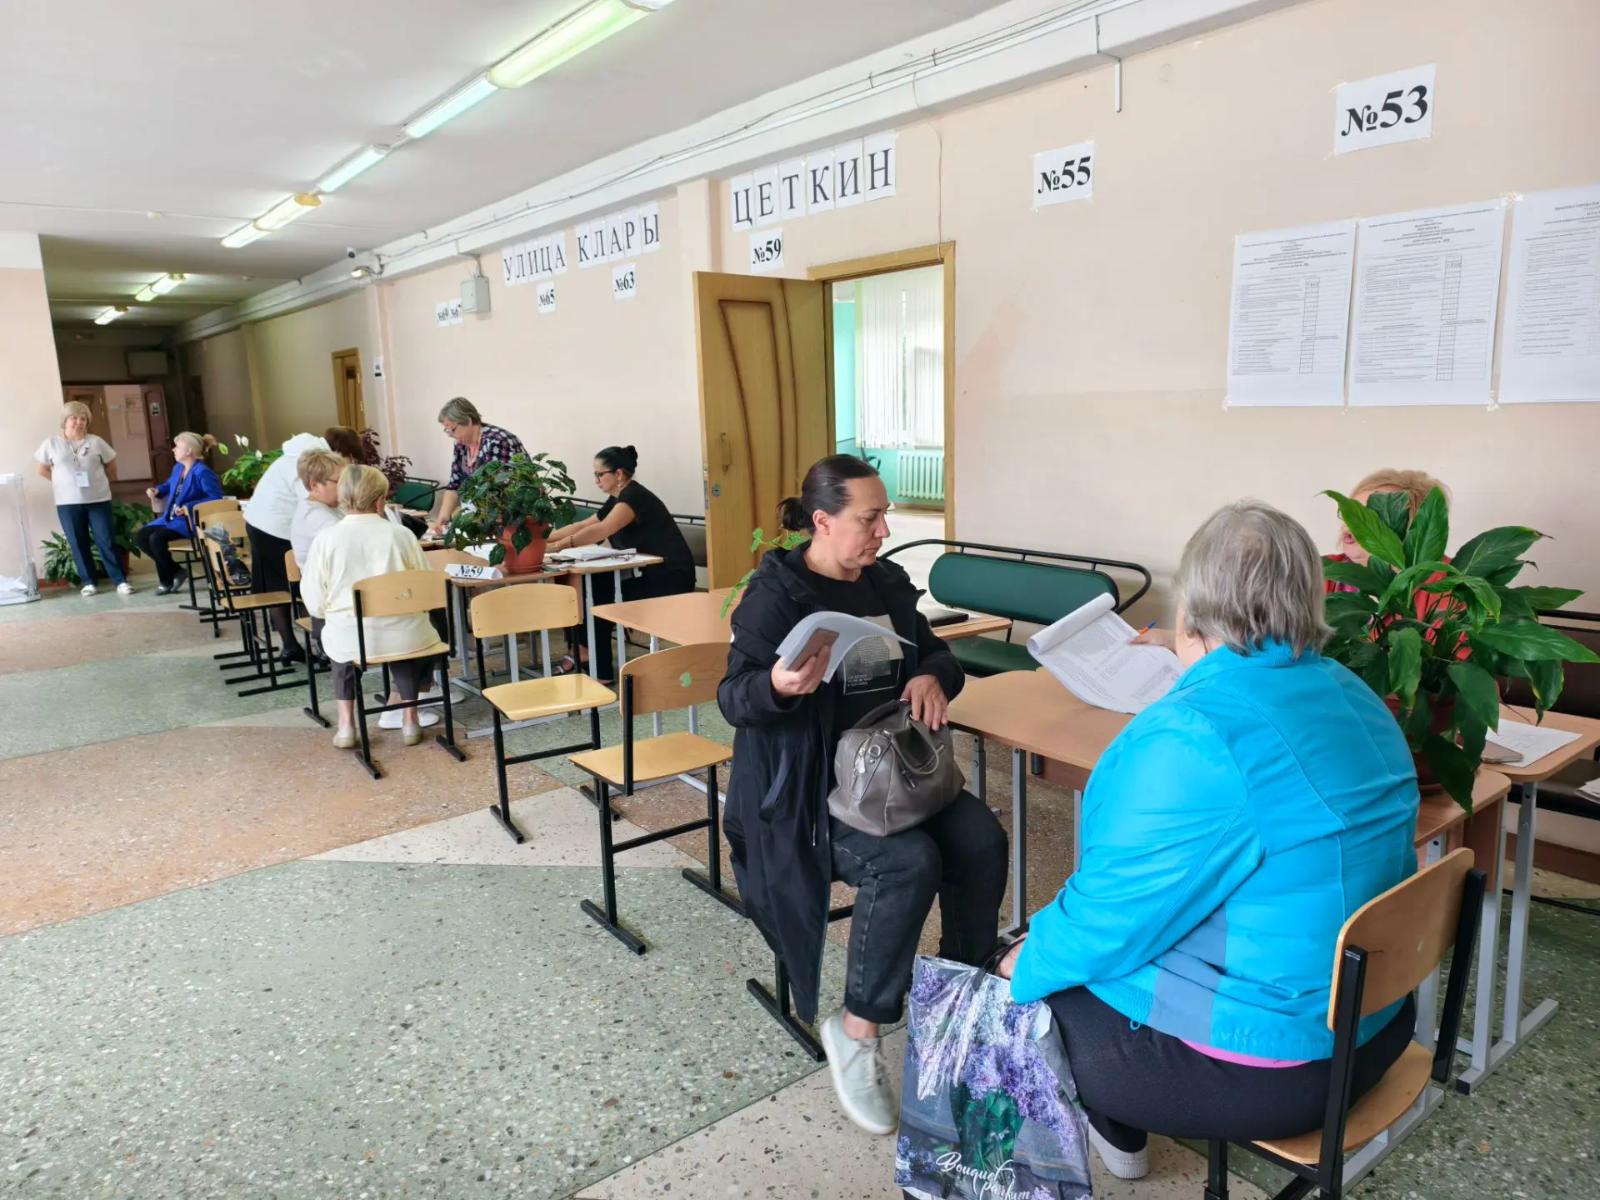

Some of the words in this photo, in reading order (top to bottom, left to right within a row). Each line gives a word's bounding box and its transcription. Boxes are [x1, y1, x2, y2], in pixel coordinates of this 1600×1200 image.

[1341, 85, 1428, 136] №53
[1037, 155, 1092, 194] №55
[503, 244, 566, 281] УЛИЦА
[577, 213, 660, 262] КЛАРЫ
[733, 147, 893, 226] ЦЕТКИН
[752, 238, 782, 265] №59
[614, 271, 635, 293] №63
